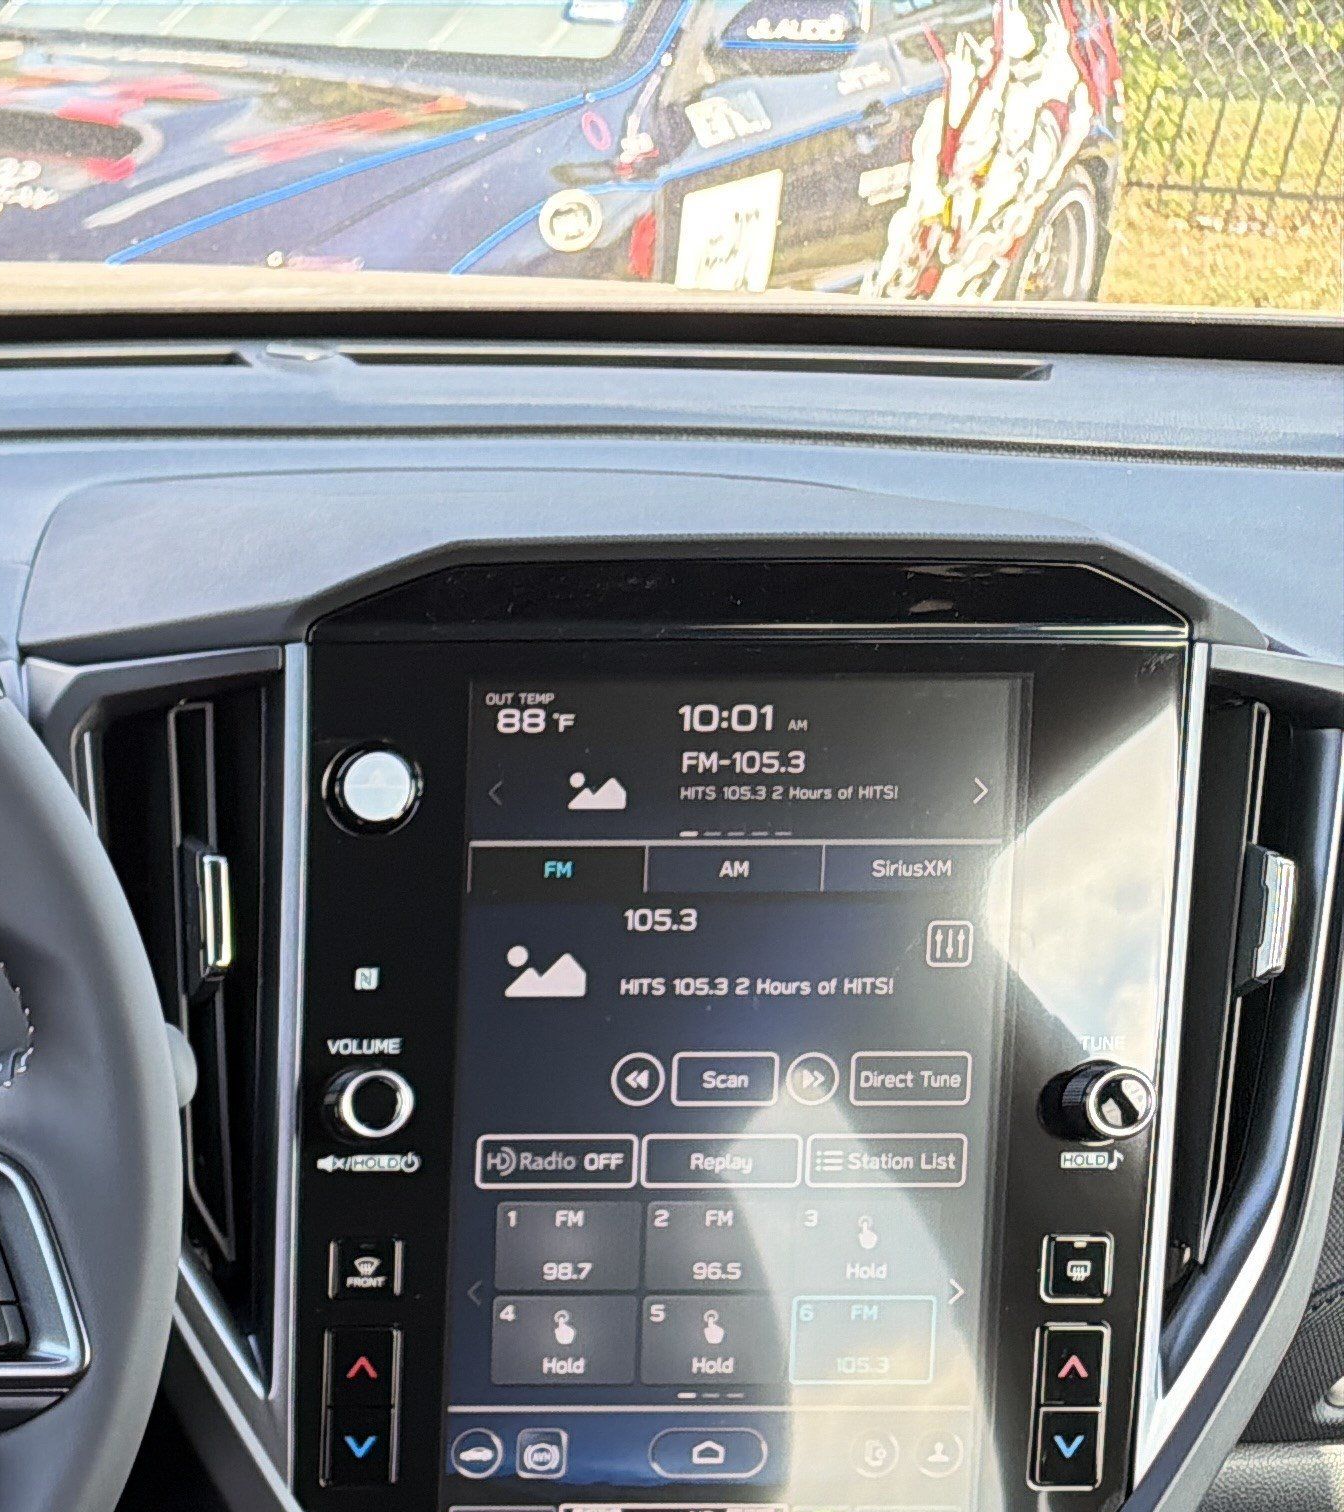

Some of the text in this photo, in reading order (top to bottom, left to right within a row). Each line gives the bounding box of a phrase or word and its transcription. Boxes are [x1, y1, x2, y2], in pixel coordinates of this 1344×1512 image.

[485, 692, 555, 706] OUT TEMP
[496, 708, 546, 734] 88
[678, 703, 808, 732] 10:01 AM
[681, 750, 806, 775] FM-105.3
[679, 784, 899, 800] HITS 105.3 2 Hours of HITS!
[543, 860, 573, 879] FM
[718, 860, 750, 879] AM
[871, 859, 952, 878] SiriusXM
[623, 908, 698, 932] 105.3
[619, 976, 895, 996] HITS 105.3 2 Hours of HITS!
[326, 1037, 403, 1056] VOLUME
[702, 1071, 749, 1089] Scan
[859, 1070, 962, 1089] Direct Tune
[352, 1155, 400, 1171] HOLD
[519, 1151, 576, 1171] Radio
[583, 1152, 625, 1171] OFF
[690, 1153, 754, 1174] Replay
[847, 1151, 956, 1171] Station List
[1062, 1153, 1108, 1168] HOLD
[507, 1209, 585, 1228] 1 FM
[653, 1209, 734, 1228] 2 FM
[803, 1209, 819, 1228] 3
[542, 1262, 593, 1281] 98.7
[692, 1262, 742, 1281] 96.5
[845, 1262, 888, 1280] Hold
[346, 1276, 387, 1288] FRONT
[498, 1304, 516, 1323] 4
[649, 1304, 666, 1323] 5
[798, 1304, 879, 1322] 6 FM
[542, 1357, 586, 1375] Hold
[691, 1357, 735, 1375] Hold
[836, 1356, 891, 1374] 105.3
